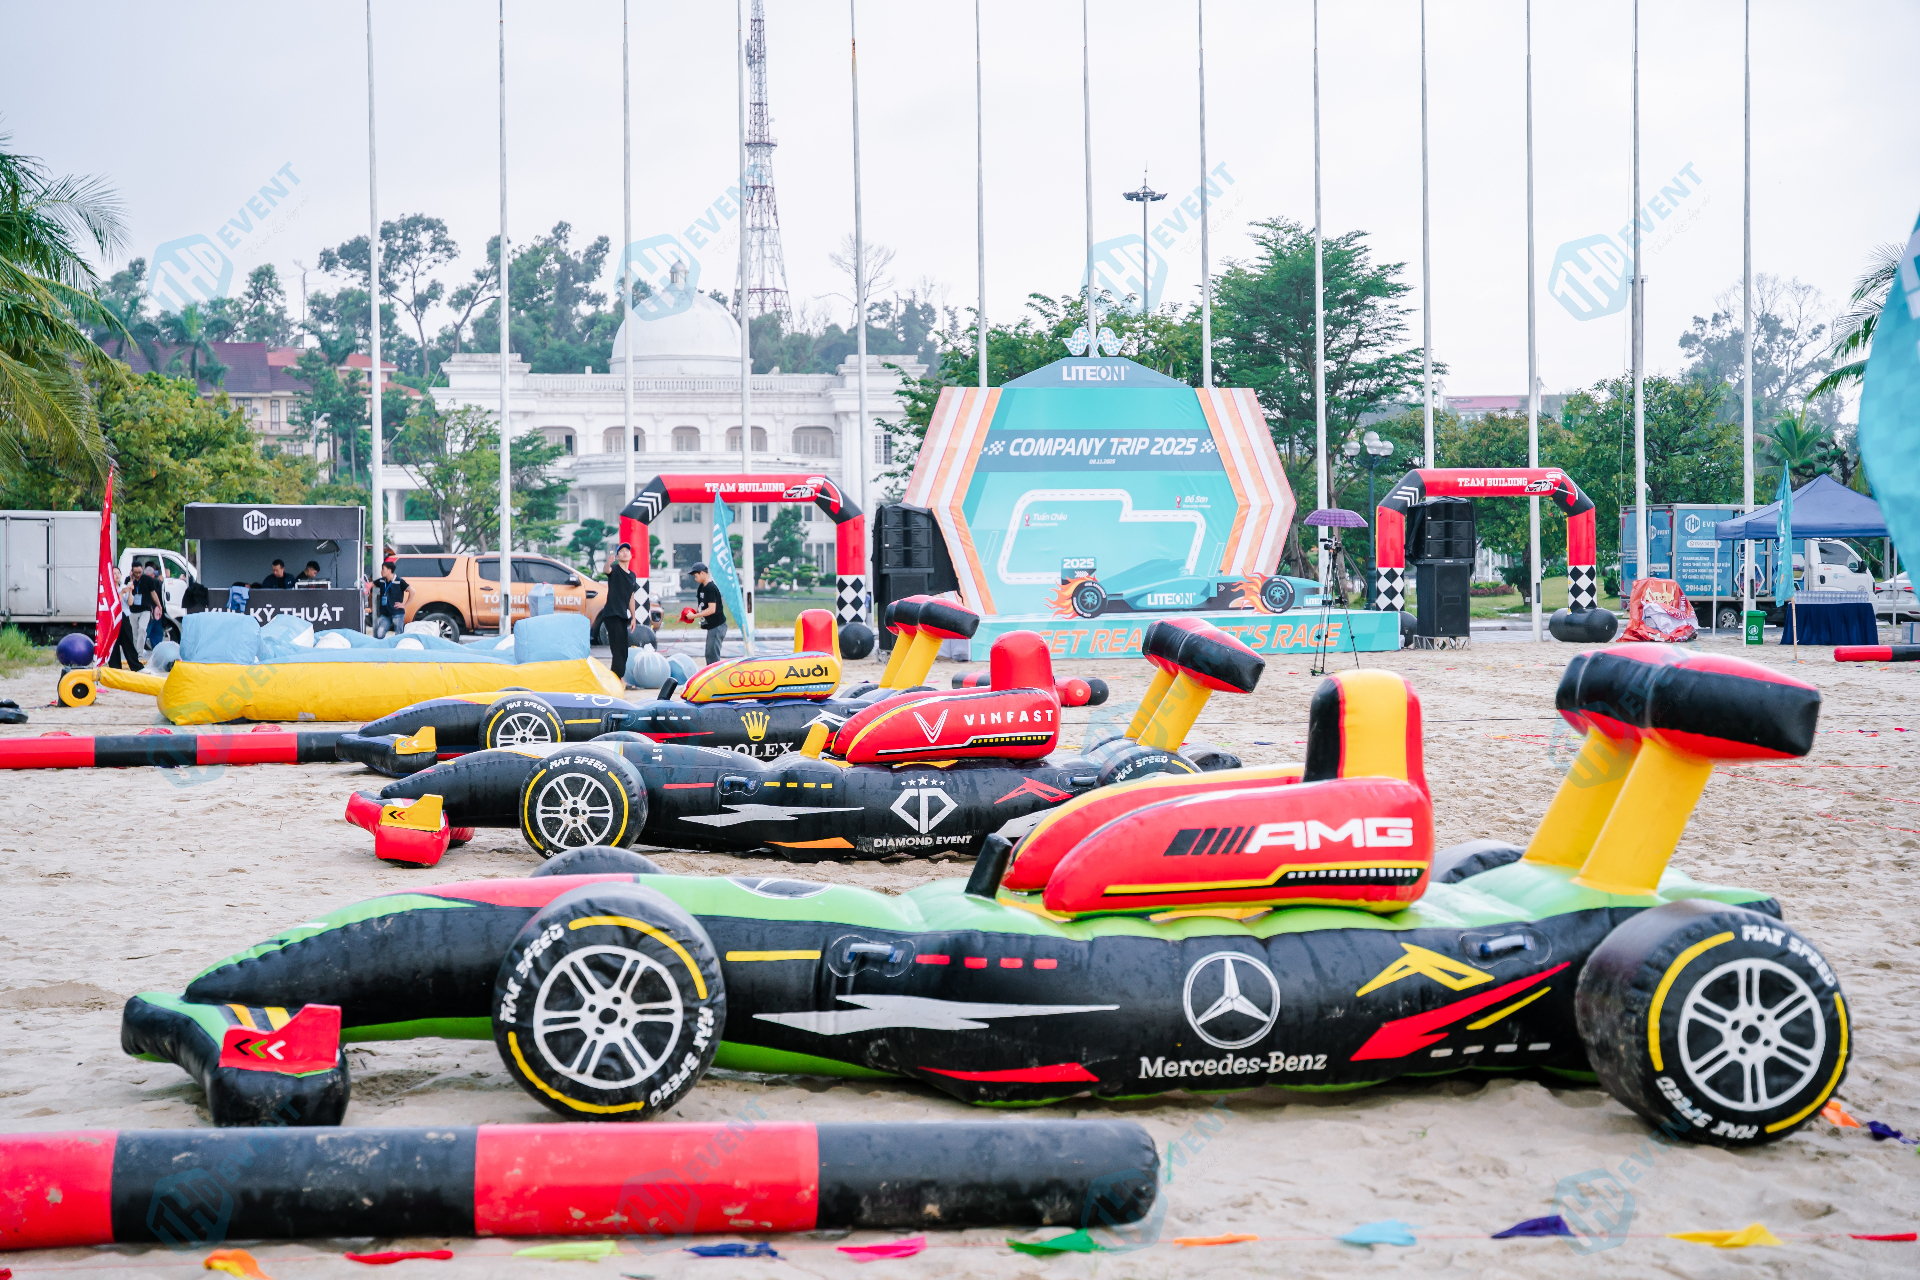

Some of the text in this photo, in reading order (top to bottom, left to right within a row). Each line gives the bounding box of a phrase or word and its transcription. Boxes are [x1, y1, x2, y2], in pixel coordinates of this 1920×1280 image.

[1062, 365, 1125, 381] LITEON
[1009, 437, 1199, 456] COMPANY TRIP 2025
[704, 482, 786, 492] TEAM BUILDING
[1457, 477, 1528, 487] TEAM BUILDING
[268, 518, 302, 527] GROUP
[1063, 558, 1095, 569] 2025
[555, 594, 582, 607] KIỆN
[1147, 592, 1193, 606] LITEON
[280, 602, 344, 625] THUẬT
[1089, 628, 1142, 653] REA
[1272, 623, 1343, 648] RACE
[784, 664, 829, 679] Audi
[523, 701, 547, 713] SPEED
[964, 710, 1053, 726] VINFAST
[574, 755, 608, 772] SPEED
[1135, 755, 1169, 768] SPEED
[873, 835, 973, 848] DIAMOND EVENT
[1244, 817, 1413, 853] AMG
[515, 923, 565, 979] SPEED
[1787, 936, 1836, 987] SPEED
[1138, 1050, 1328, 1079] Mercedes-Benz
[650, 1051, 700, 1107] SPEED
[1655, 1075, 1714, 1128] SPEED
